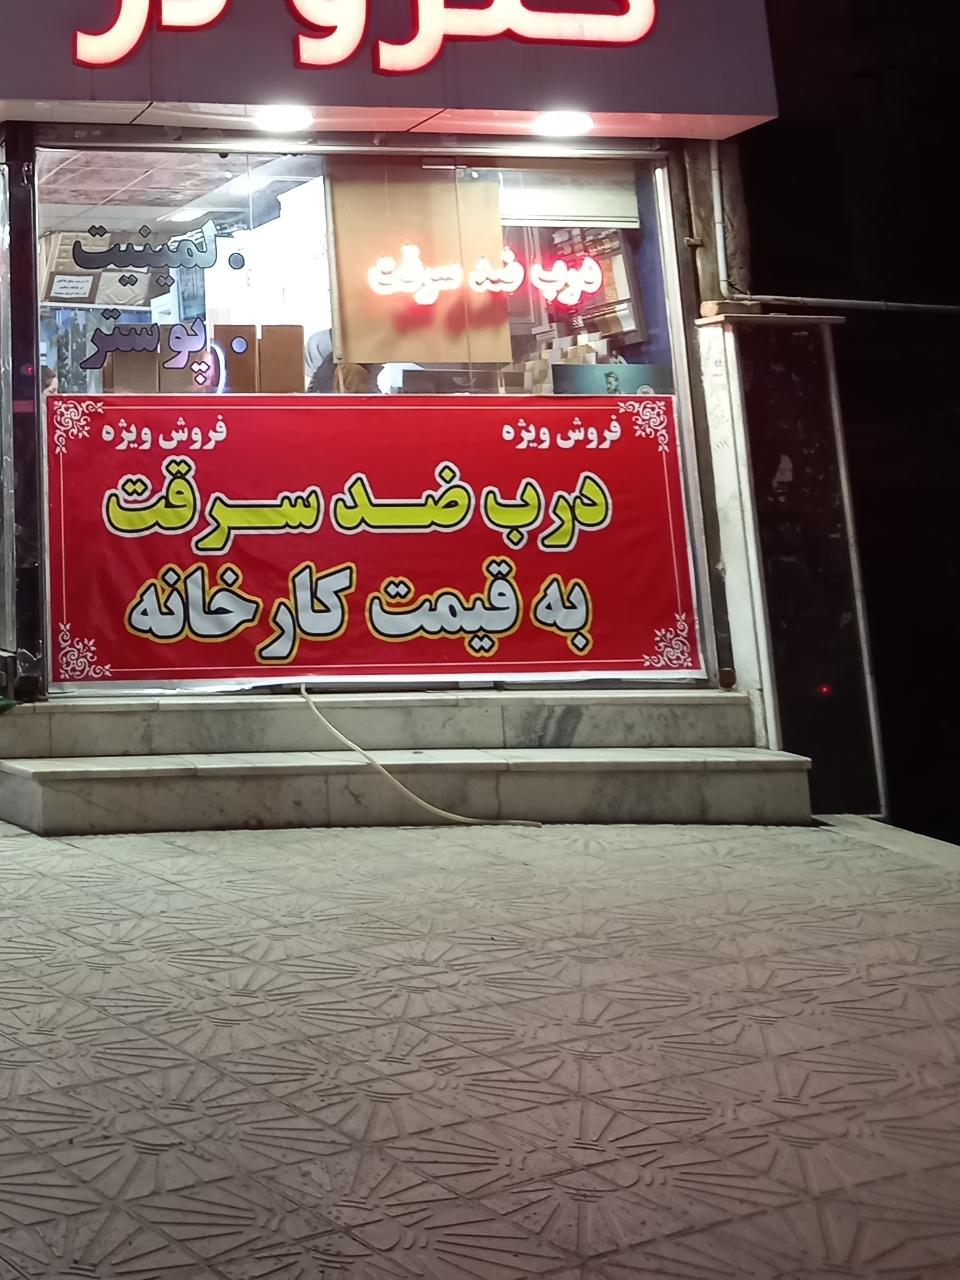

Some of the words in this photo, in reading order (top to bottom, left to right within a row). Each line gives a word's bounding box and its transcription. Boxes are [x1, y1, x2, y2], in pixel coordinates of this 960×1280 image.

[367, 242, 464, 305] سرقت
[468, 245, 525, 294] ضد
[80, 308, 208, 385] پوستر
[101, 417, 153, 450] ویژه
[158, 414, 228, 450] فروش
[502, 420, 550, 449] ویژه
[557, 417, 622, 450] فروش
[102, 455, 321, 556] سرقت
[333, 461, 472, 533] ضد
[483, 472, 613, 553] درب
[368, 556, 521, 659] قیمت
[530, 573, 594, 655] به
